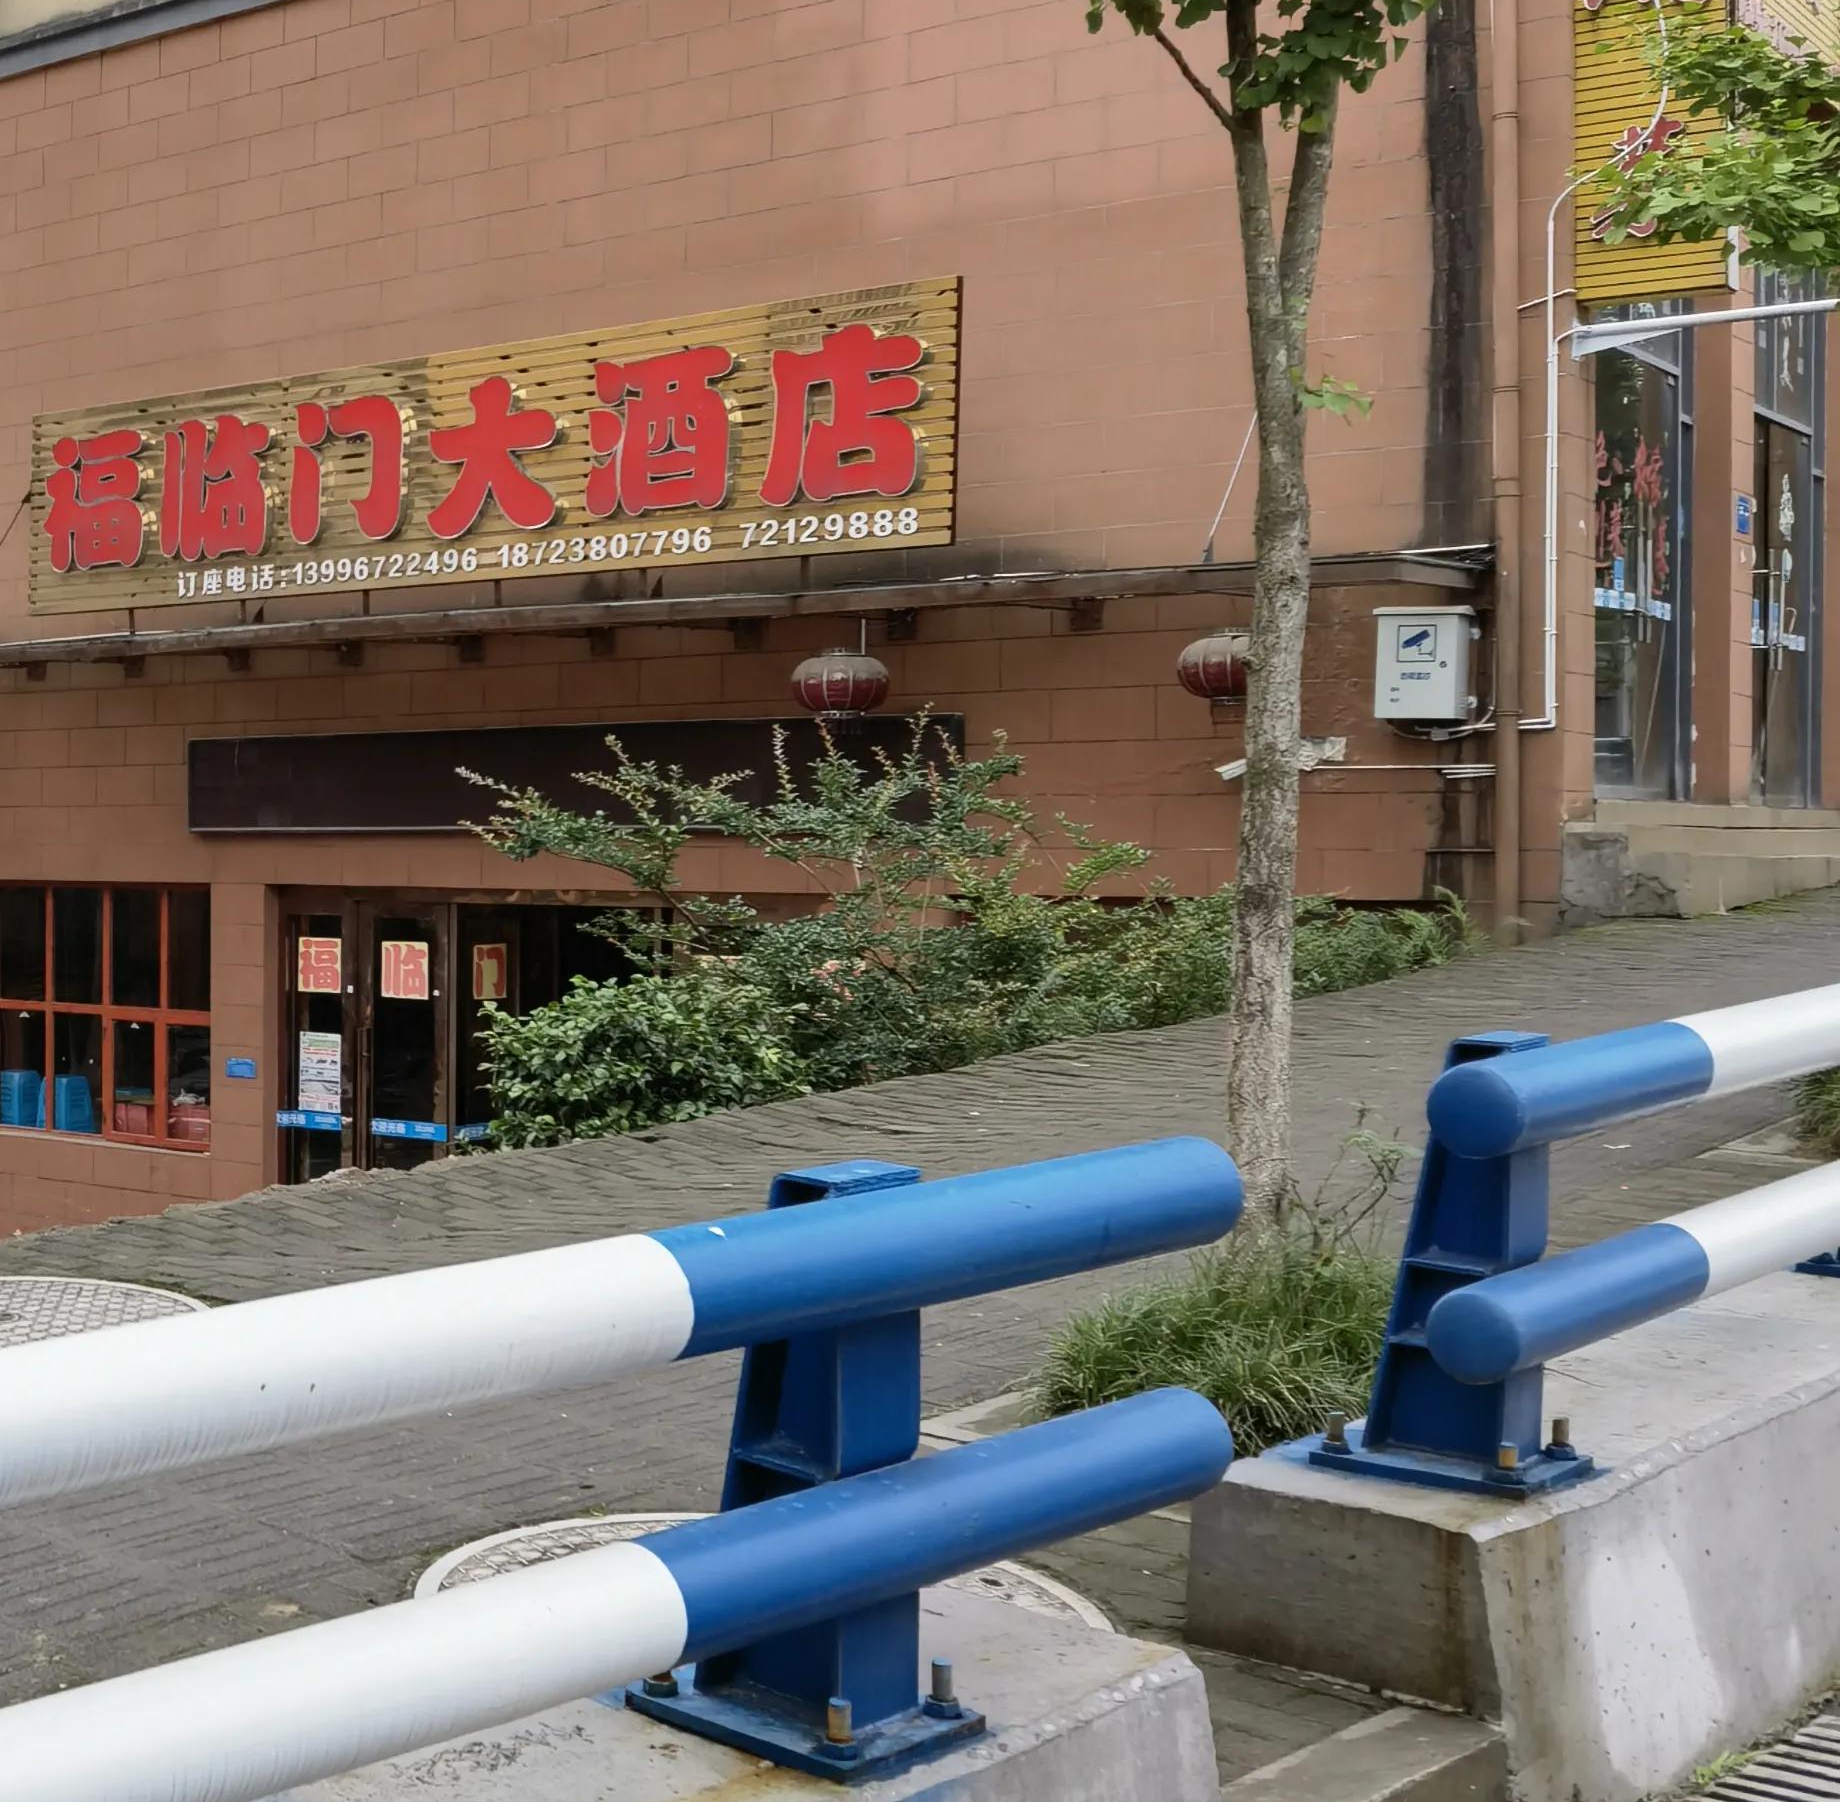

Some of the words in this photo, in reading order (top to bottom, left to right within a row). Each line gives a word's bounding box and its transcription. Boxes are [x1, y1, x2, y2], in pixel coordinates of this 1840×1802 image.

[44, 323, 925, 573] 福临门大酒店
[497, 526, 712, 569] 18723807796
[739, 507, 919, 549] 72129888
[300, 939, 339, 990] 福
[384, 944, 427, 997] 临
[475, 946, 505, 998] 门
